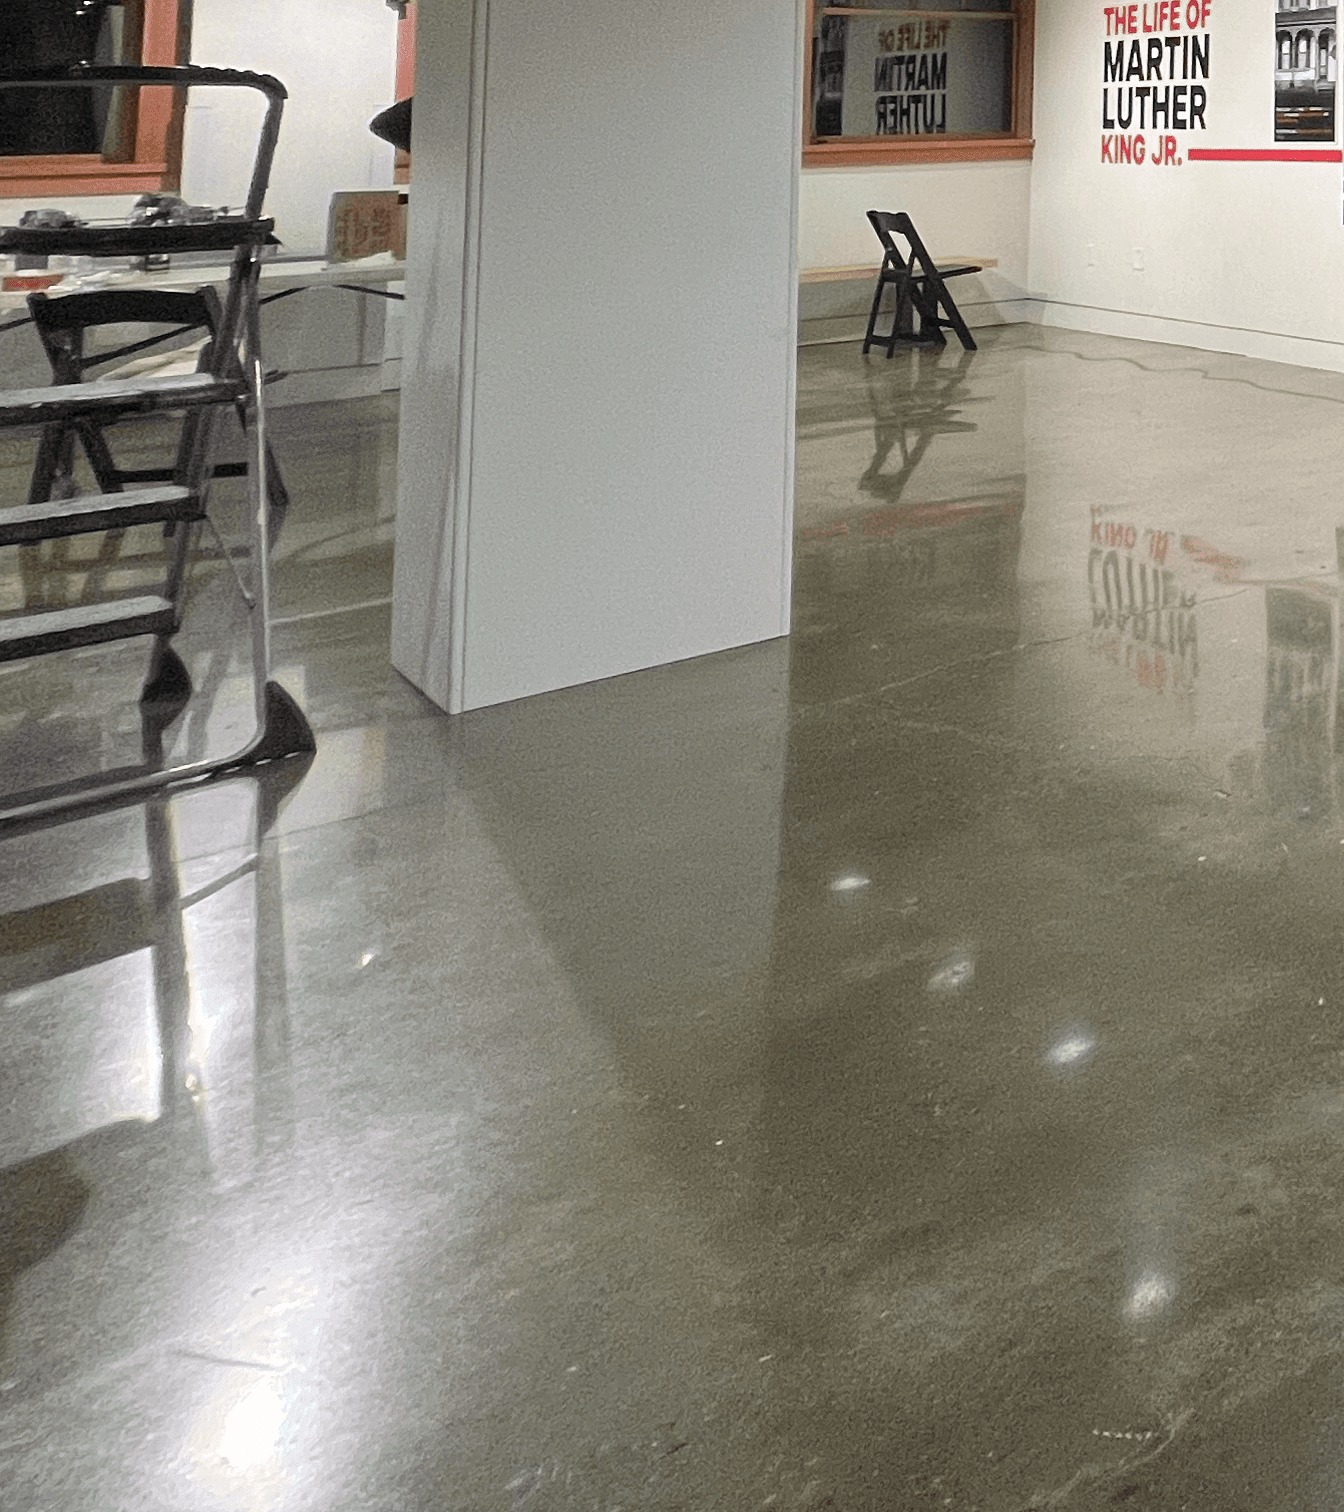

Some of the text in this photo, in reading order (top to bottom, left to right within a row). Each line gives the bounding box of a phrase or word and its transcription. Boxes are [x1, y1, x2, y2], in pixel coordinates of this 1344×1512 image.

[1104, 4, 1139, 36] THE
[1143, 0, 1181, 33] LIFE
[1103, 33, 1210, 83] MARTIN
[1102, 85, 1207, 130] LUTHER
[1101, 134, 1183, 166] KING JR.
